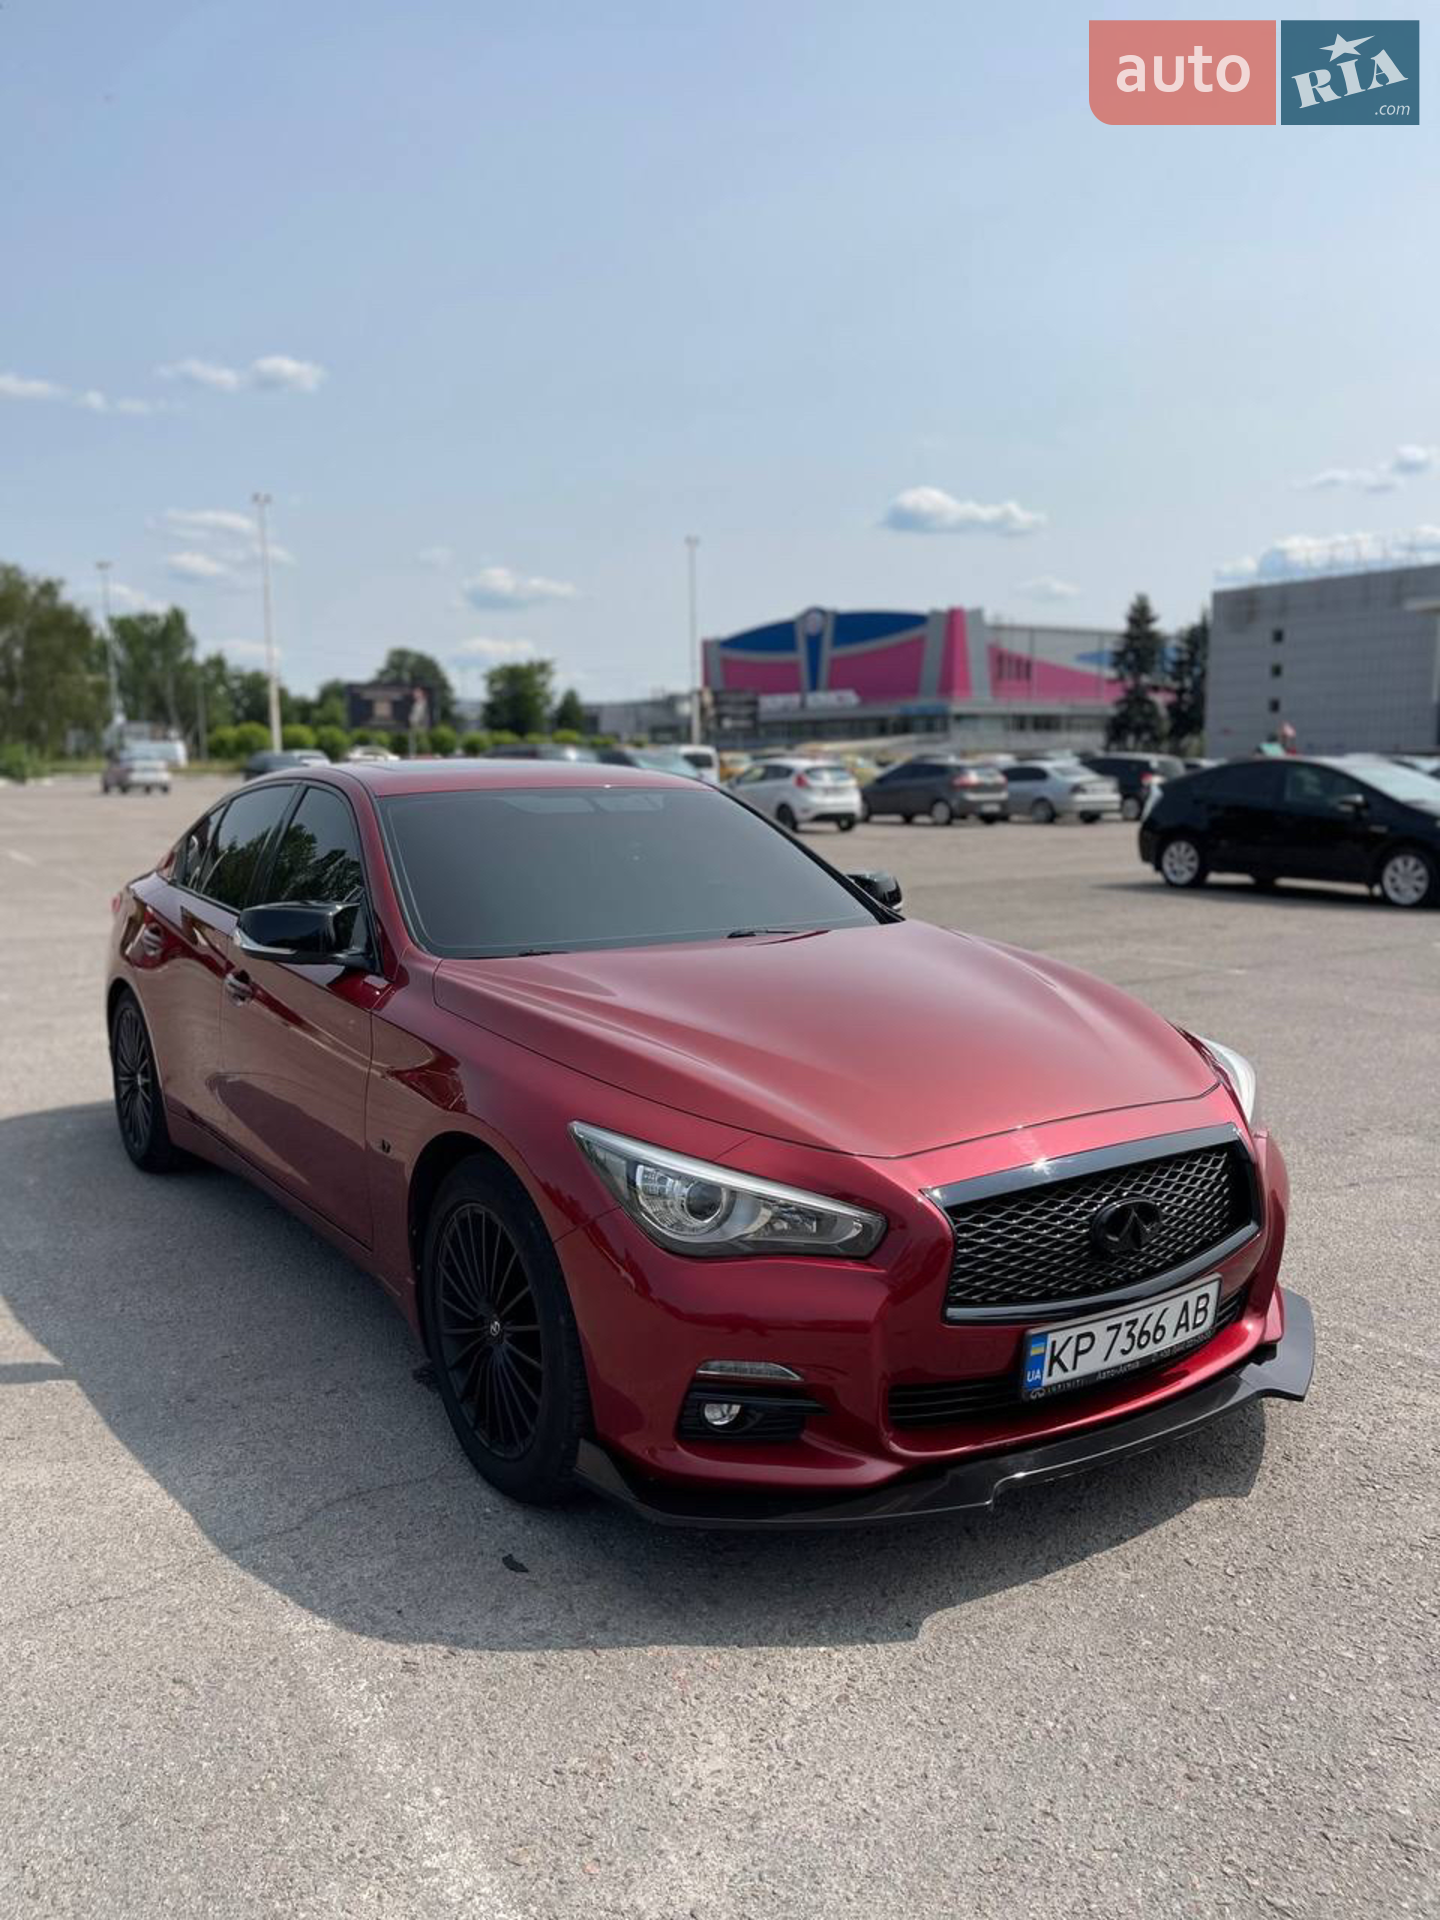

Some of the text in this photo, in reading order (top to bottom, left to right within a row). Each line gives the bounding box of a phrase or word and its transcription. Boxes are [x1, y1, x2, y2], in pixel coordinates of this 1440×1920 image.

[1047, 1331, 1096, 1378] KP
[1103, 1307, 1170, 1362] 7366
[1173, 1292, 1211, 1338] AB
[1026, 1368, 1042, 1382] UA
